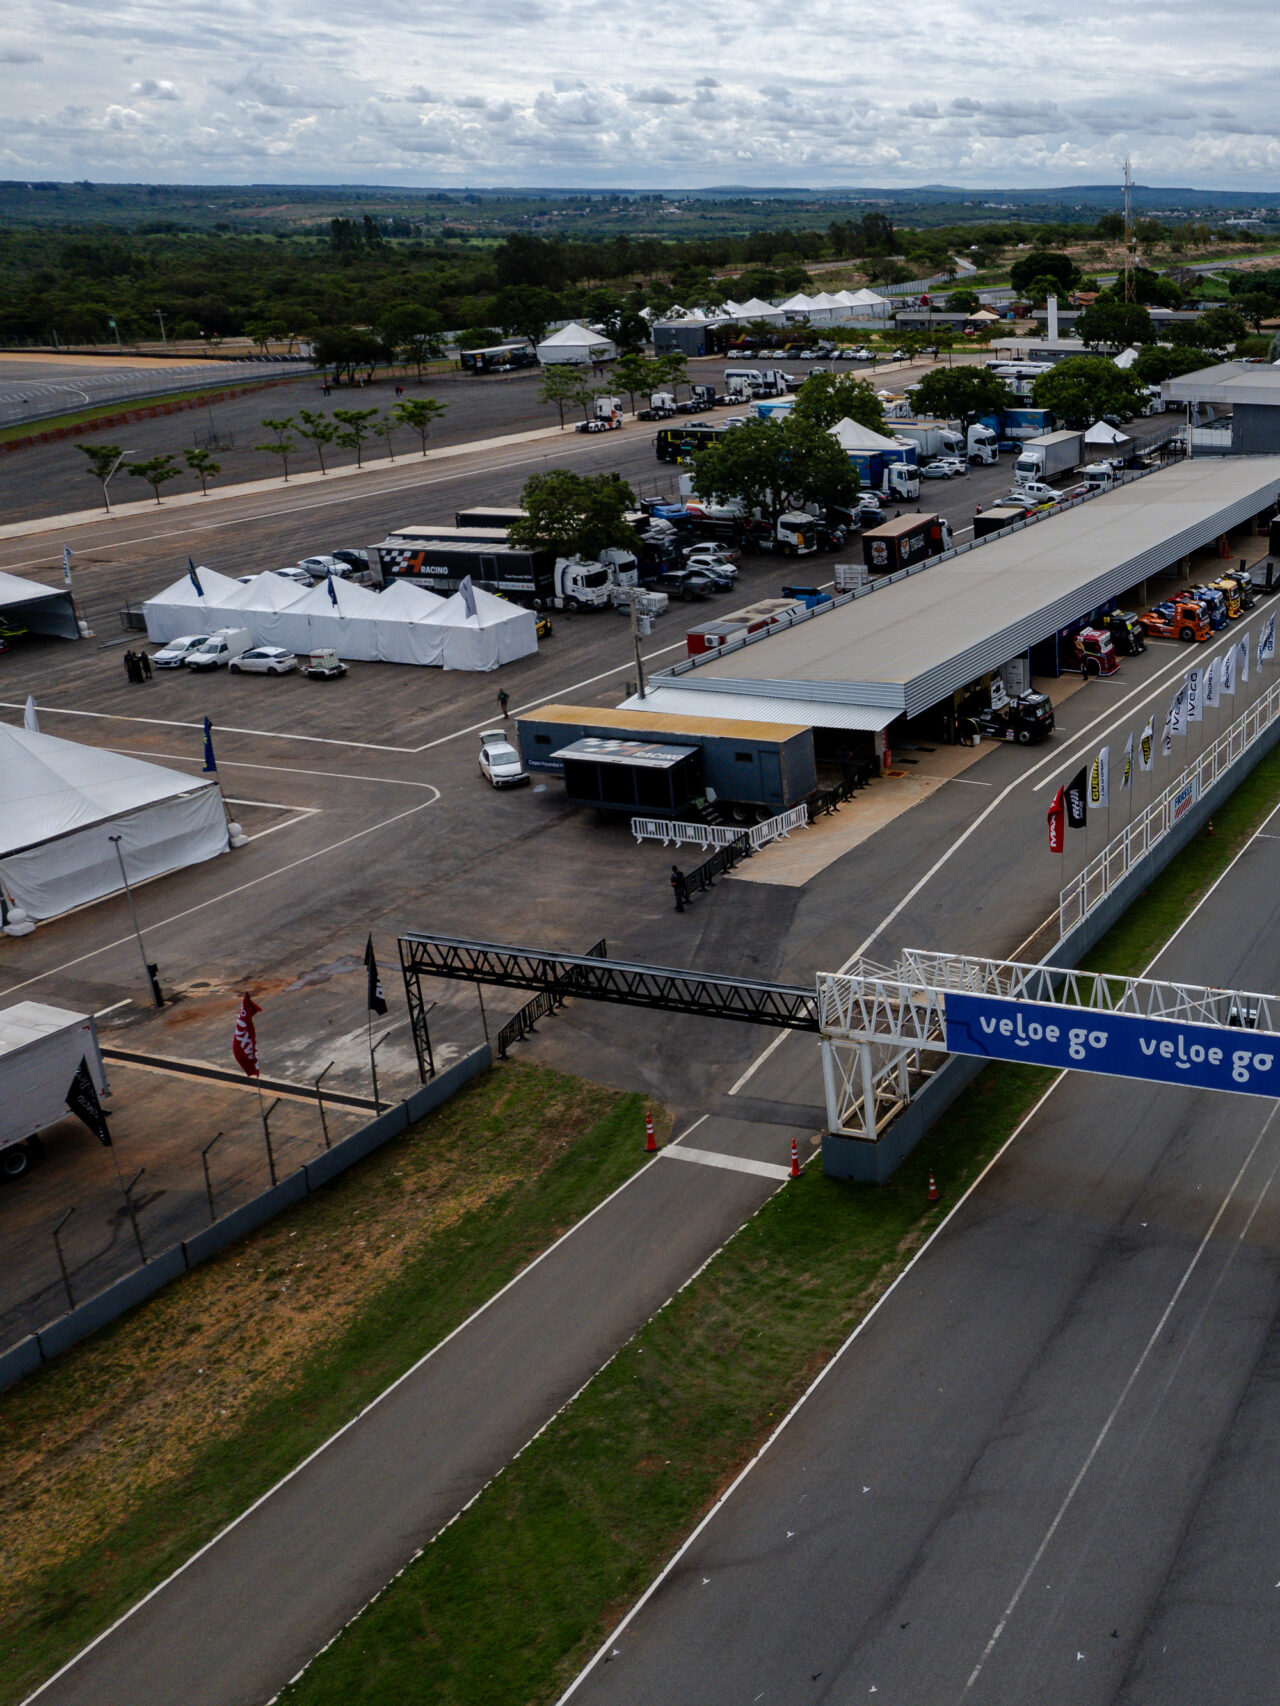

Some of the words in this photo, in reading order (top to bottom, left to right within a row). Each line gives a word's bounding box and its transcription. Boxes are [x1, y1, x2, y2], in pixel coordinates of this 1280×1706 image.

[420, 565, 449, 575] RACING
[1188, 672, 1198, 716] IVECO
[632, 751, 684, 761] RACING
[979, 1011, 1060, 1047] veloe
[1067, 1028, 1109, 1061] go
[1138, 1034, 1222, 1069] veloe
[1231, 1050, 1275, 1083] go
